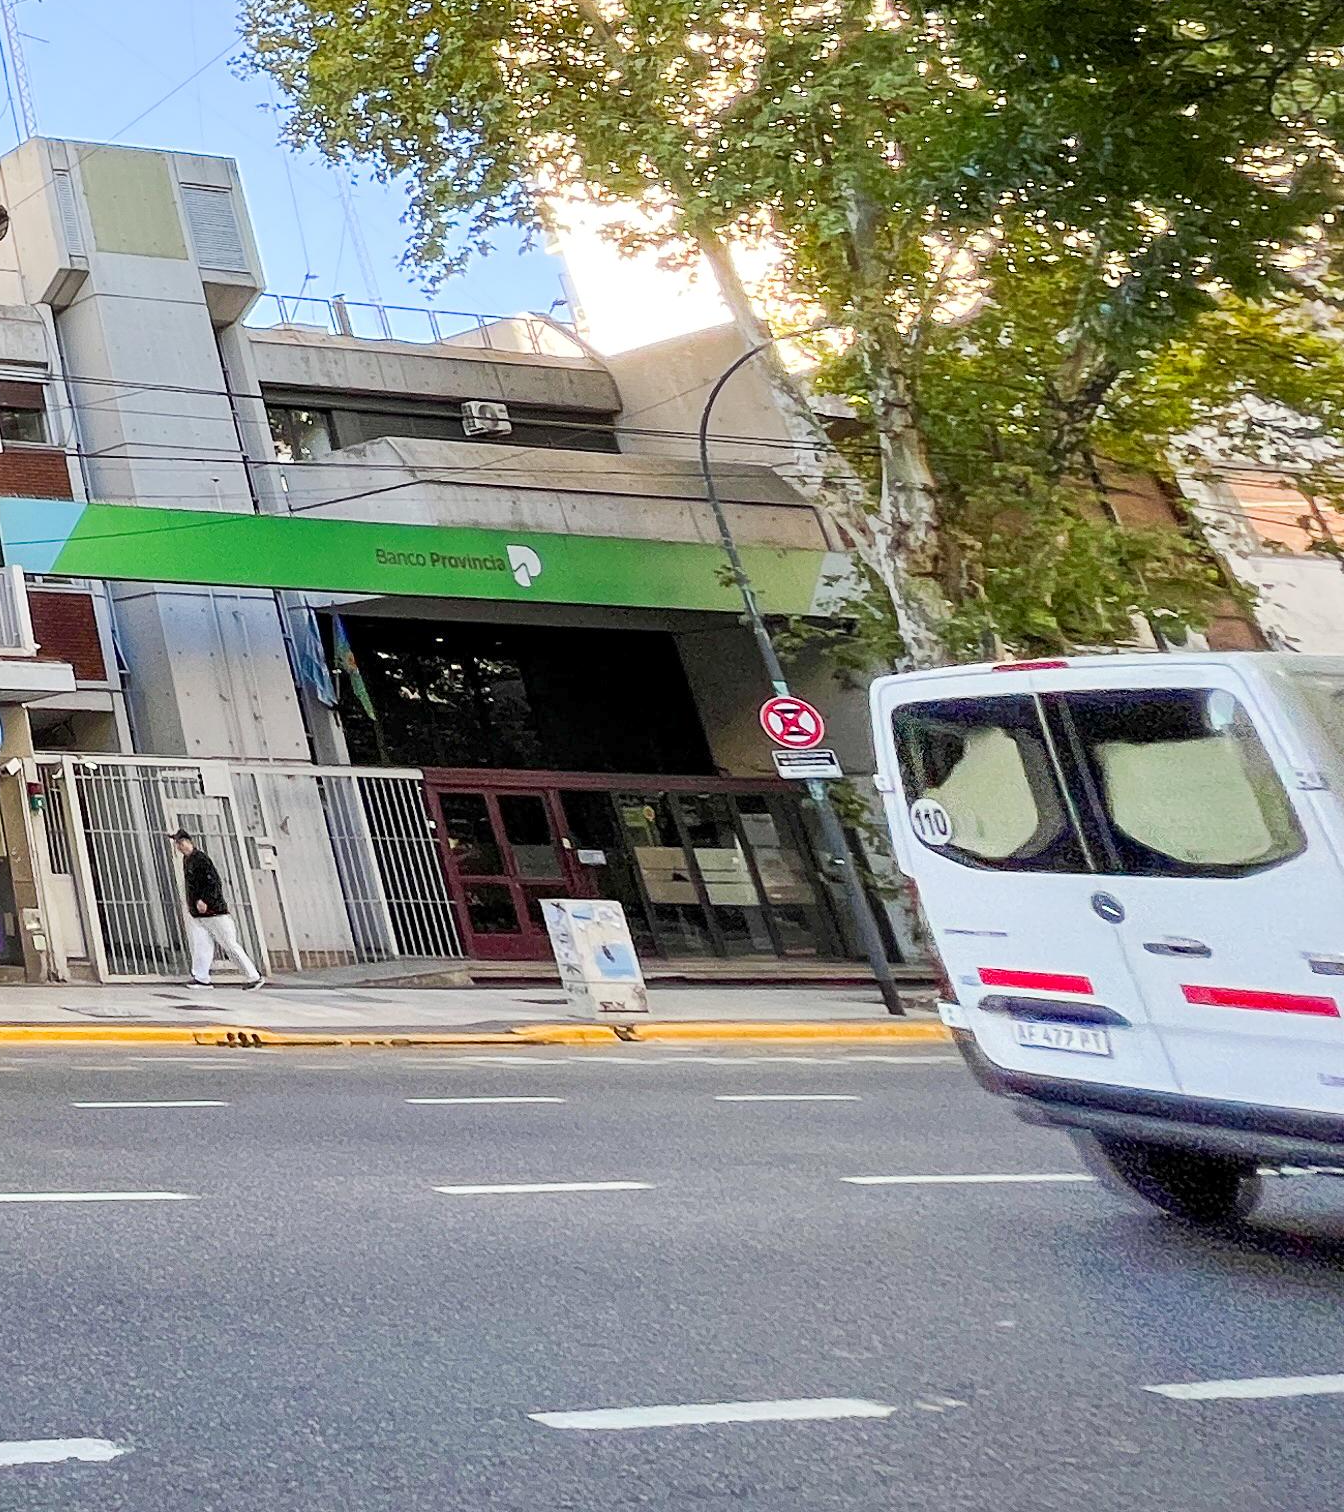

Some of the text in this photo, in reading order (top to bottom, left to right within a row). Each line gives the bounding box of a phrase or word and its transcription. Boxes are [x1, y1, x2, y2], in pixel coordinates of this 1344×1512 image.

[376, 548, 506, 571] Banco Provincia
[915, 808, 947, 836] 110
